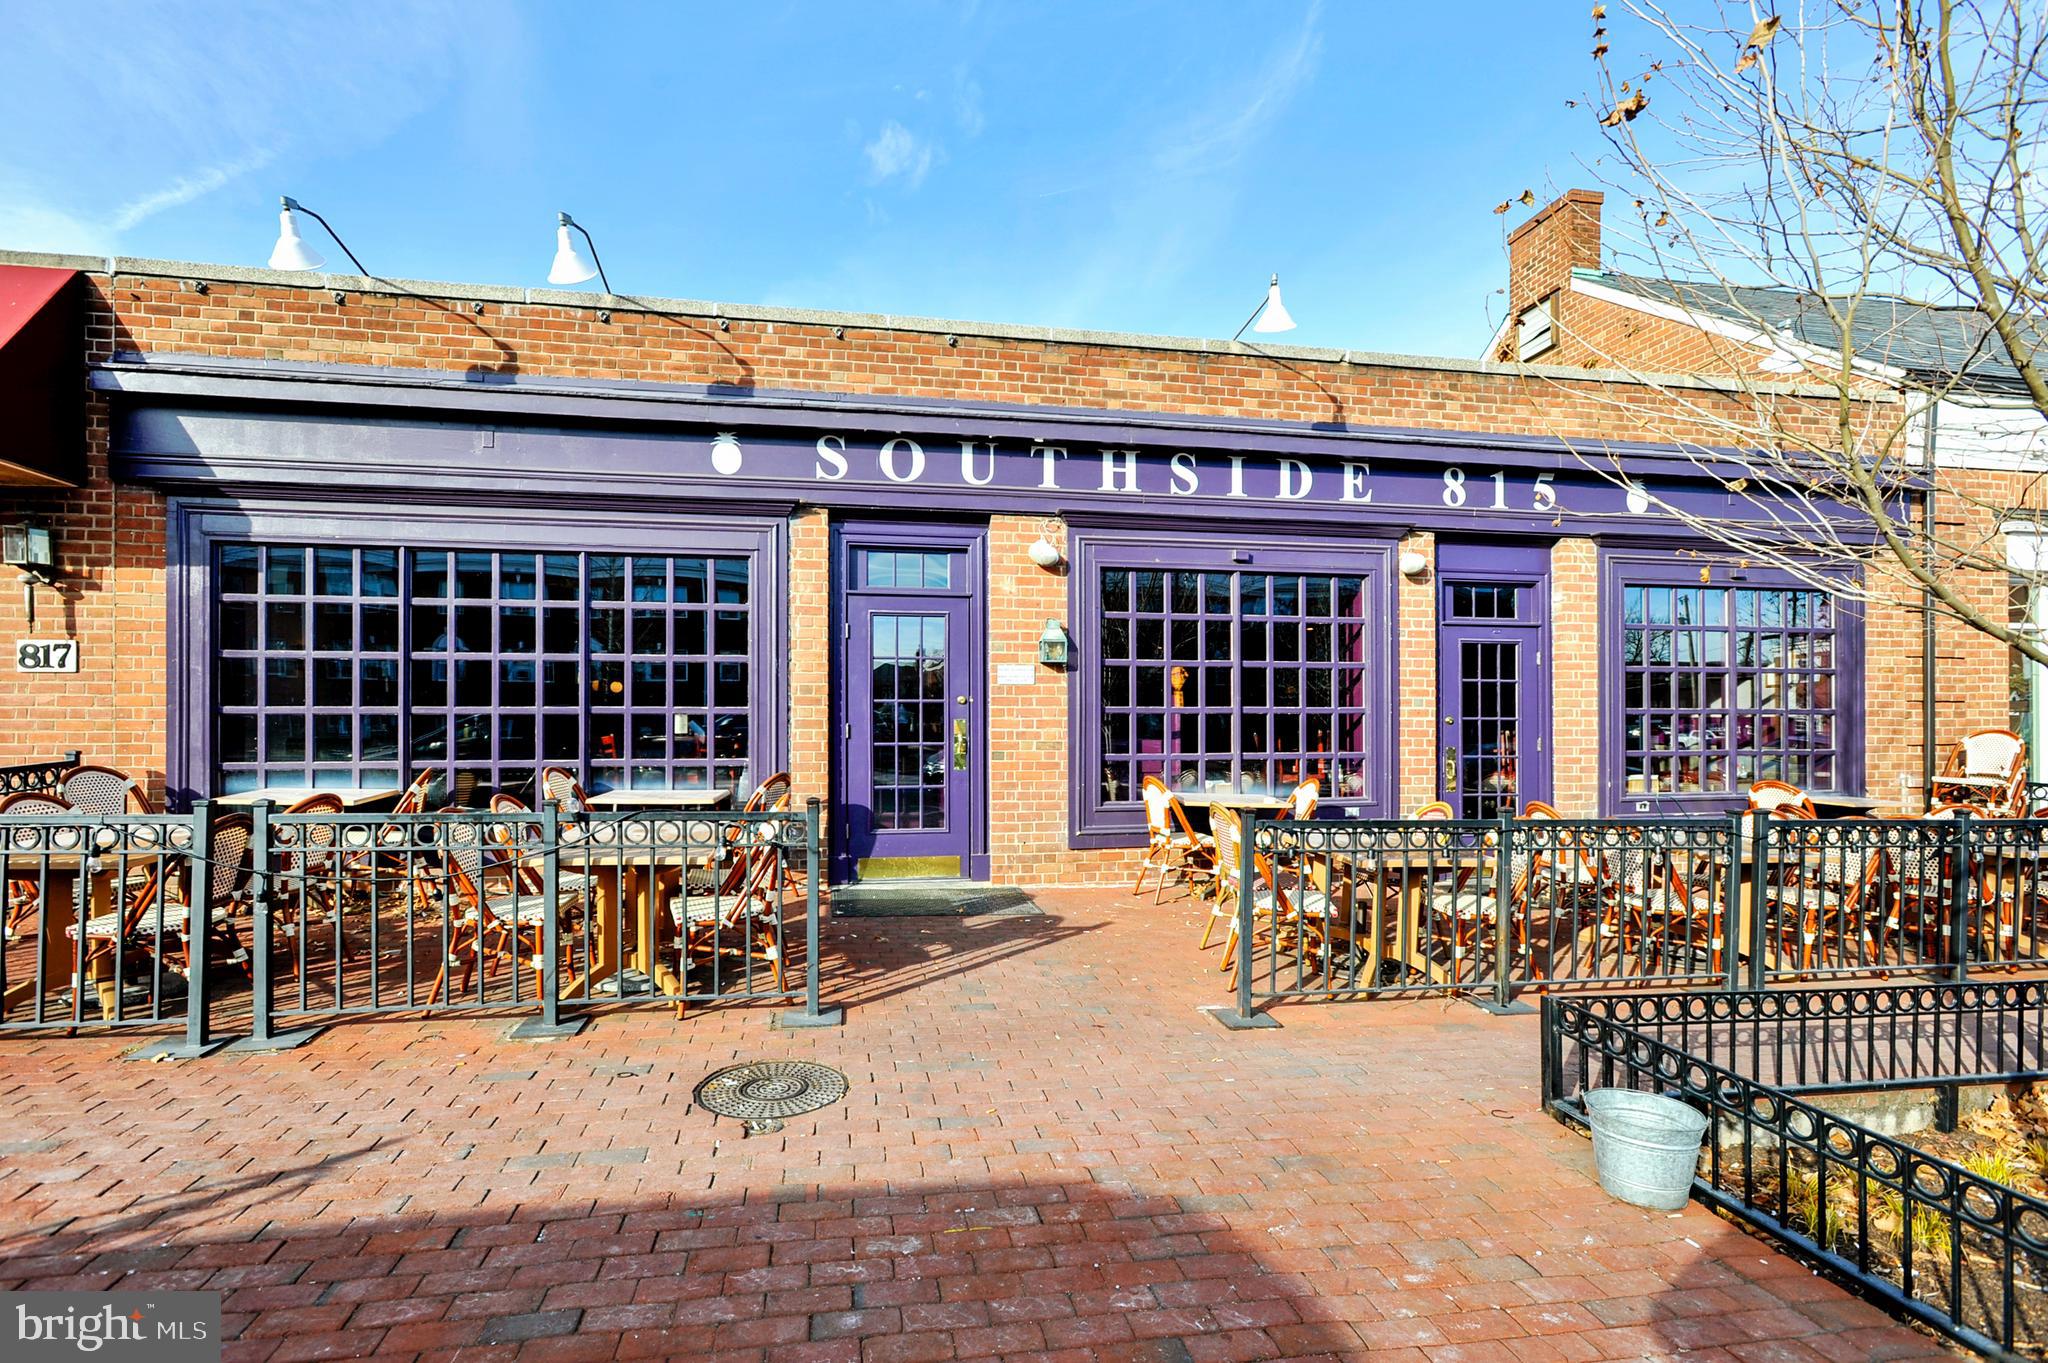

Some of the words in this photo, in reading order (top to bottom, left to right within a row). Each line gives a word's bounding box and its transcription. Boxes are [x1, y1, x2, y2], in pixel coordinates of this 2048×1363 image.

[815, 435, 1373, 502] SOUTHSIDE
[1442, 467, 1556, 511] 815
[18, 643, 72, 669] 817
